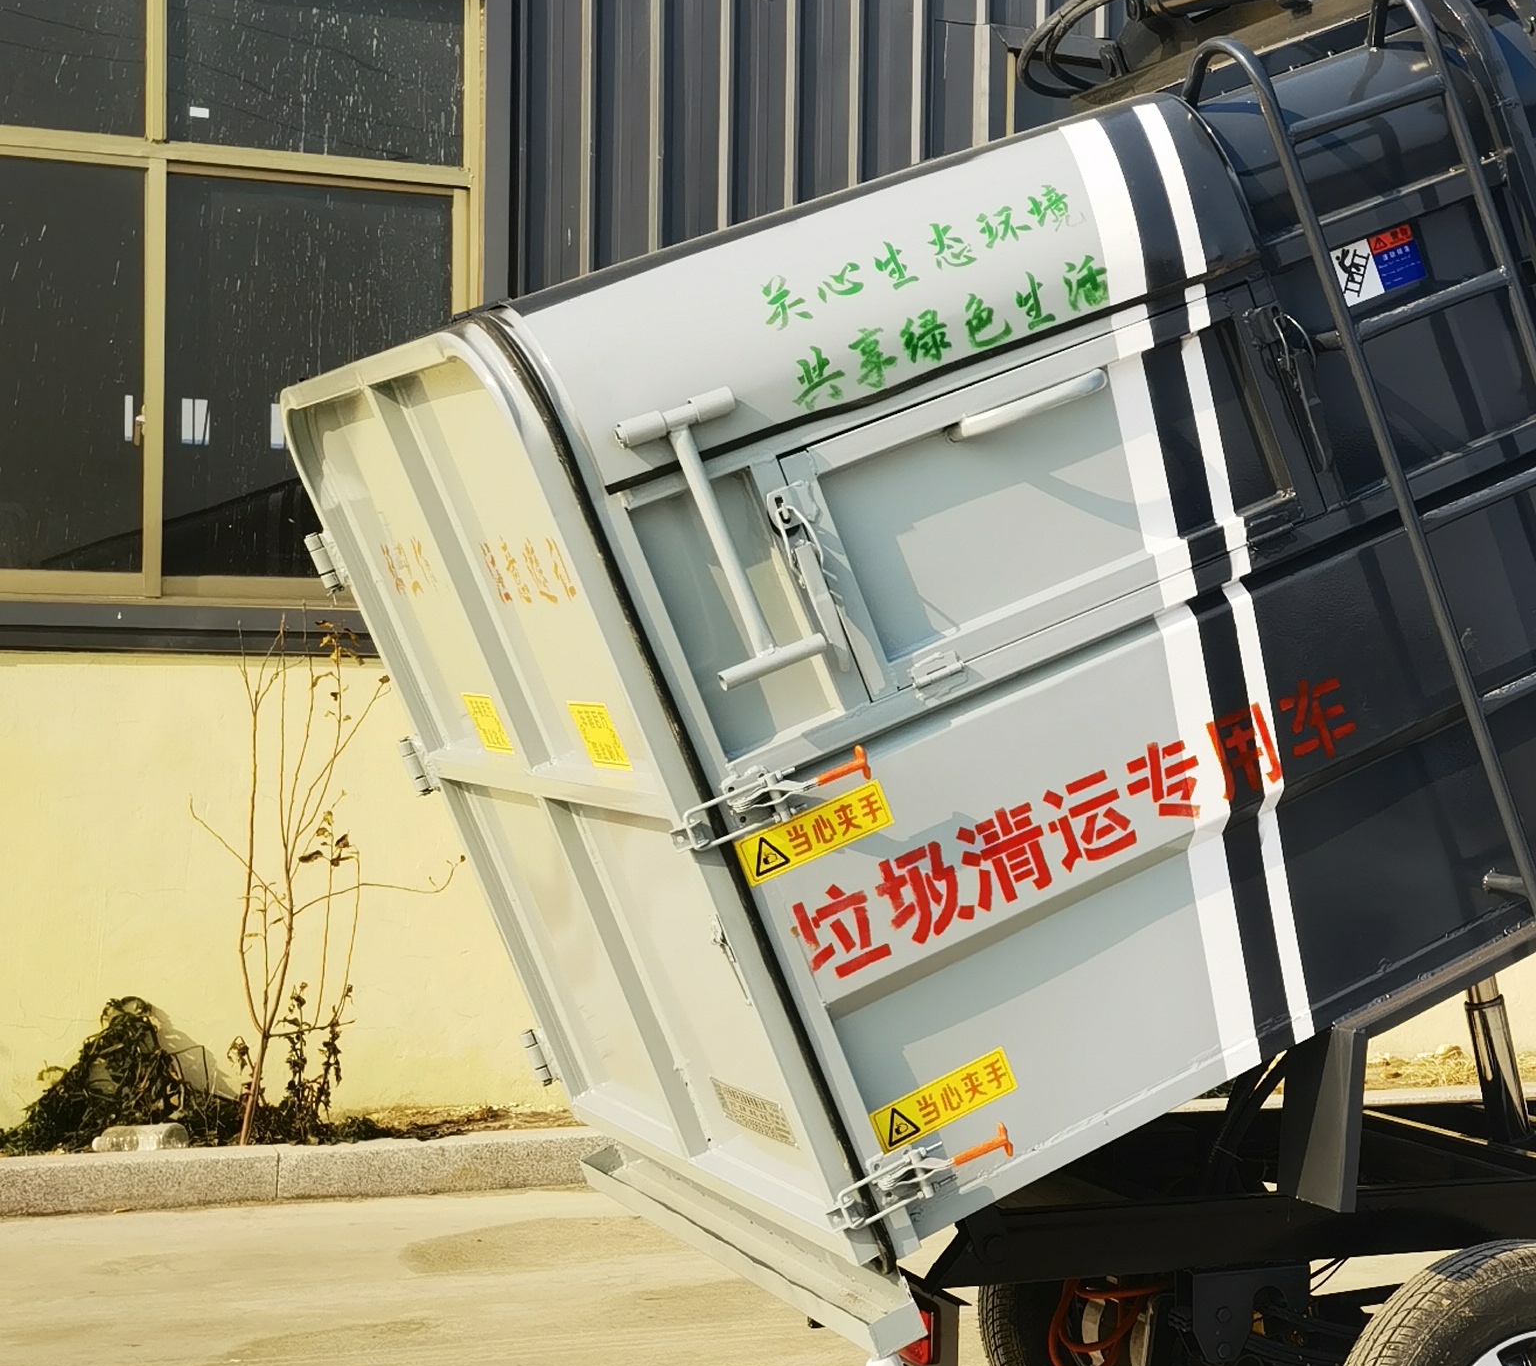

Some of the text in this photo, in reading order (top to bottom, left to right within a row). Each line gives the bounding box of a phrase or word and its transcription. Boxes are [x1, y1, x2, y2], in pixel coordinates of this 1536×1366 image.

[760, 184, 1087, 331] 关心生态环境
[792, 254, 1110, 411] 共享绿色生活
[785, 791, 883, 858] 当心夹手
[791, 677, 1357, 979] 垃圾清运专用车
[915, 1058, 1007, 1126] 当心夹手
